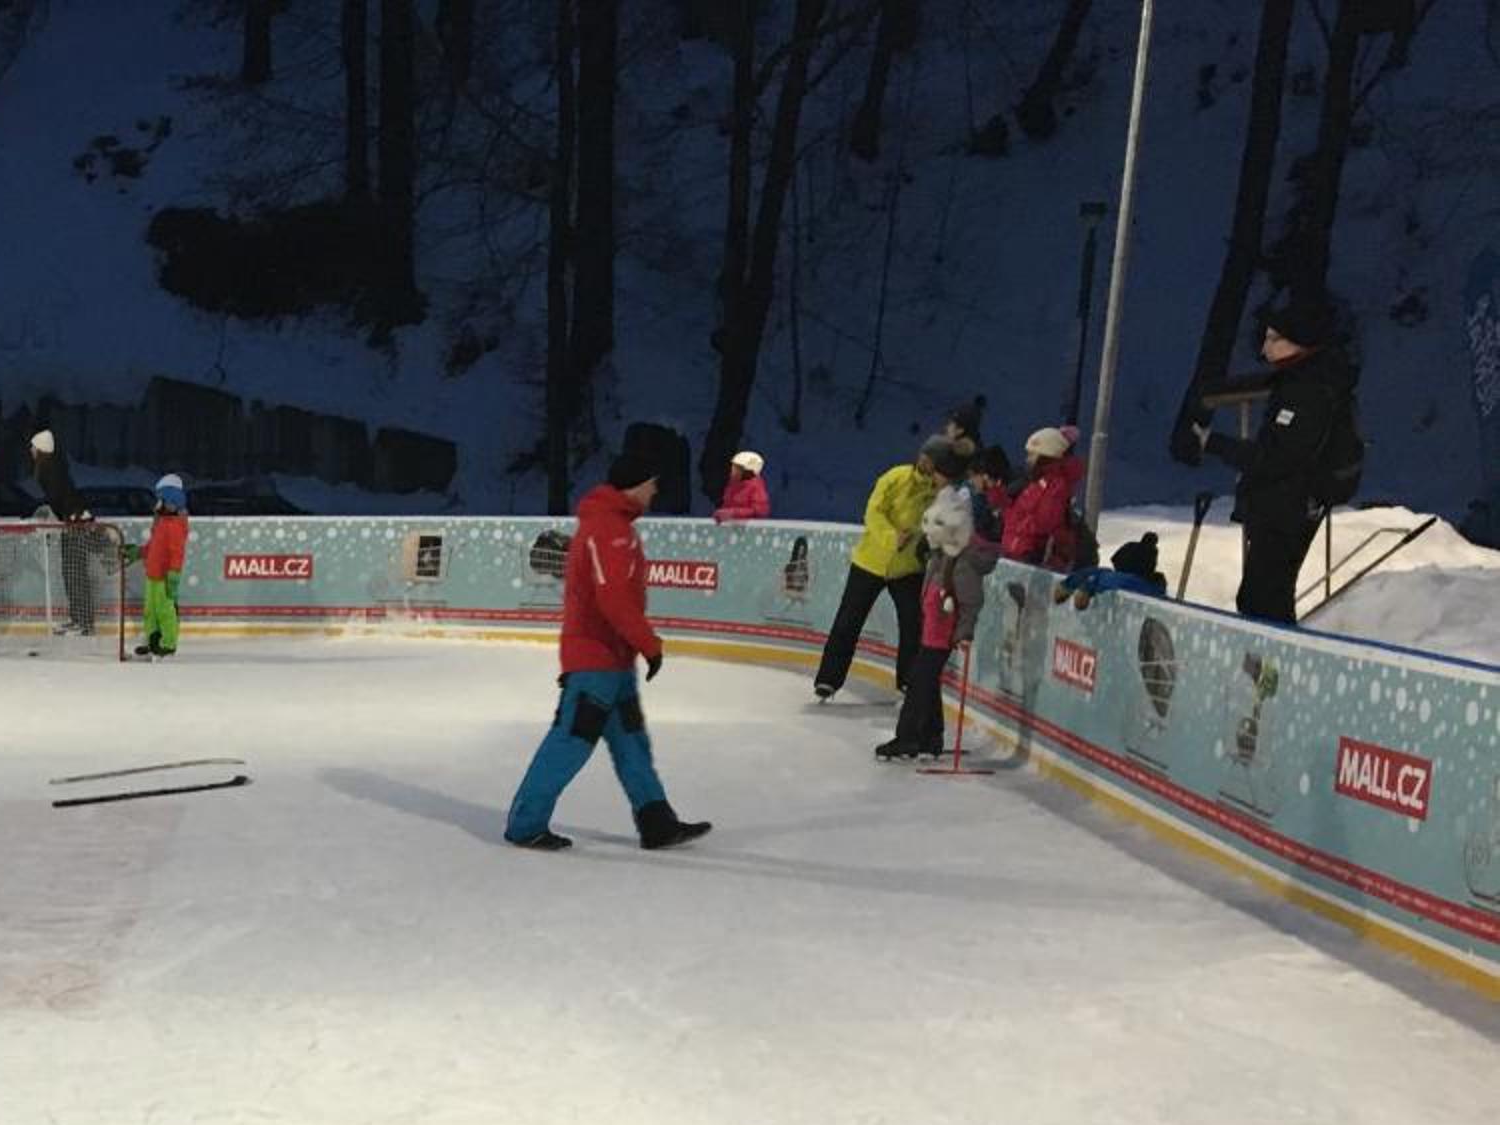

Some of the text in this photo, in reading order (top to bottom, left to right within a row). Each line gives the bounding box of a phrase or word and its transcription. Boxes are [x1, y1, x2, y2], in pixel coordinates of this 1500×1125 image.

[228, 558, 308, 576] MALL.CZ
[648, 564, 715, 586] MALL.CZ
[1339, 747, 1426, 810] MALL.CZ
